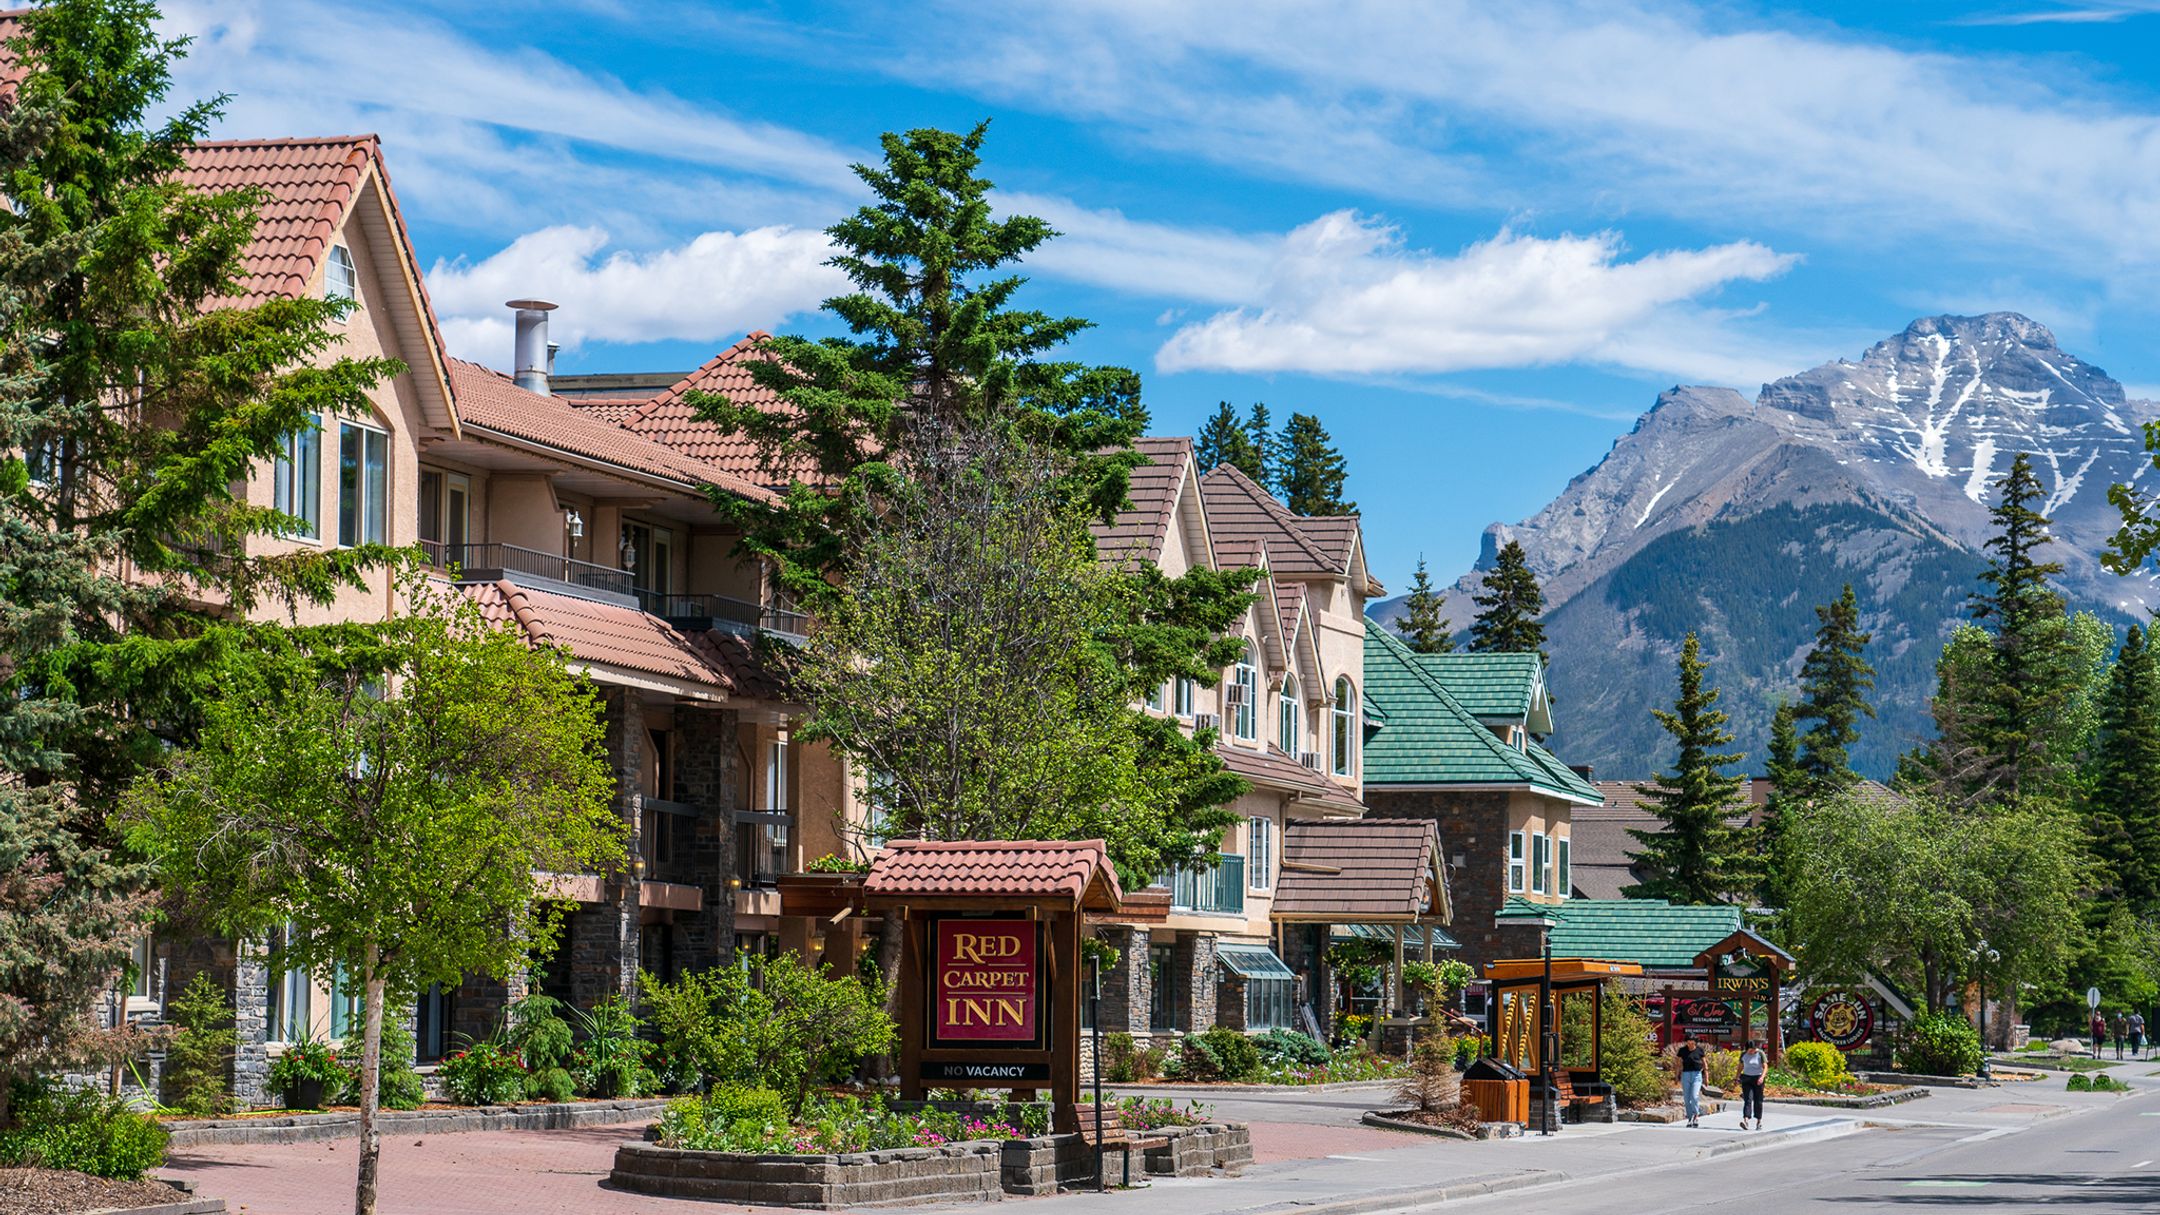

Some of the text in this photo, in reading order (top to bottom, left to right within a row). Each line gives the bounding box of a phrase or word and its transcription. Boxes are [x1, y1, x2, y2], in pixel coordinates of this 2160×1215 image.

[953, 934, 1021, 964] RED
[943, 971, 1029, 989] CARPET
[1717, 977, 1769, 992] IRWIN'S
[945, 998, 1027, 1026] INN
[1814, 993, 1867, 1020] SAMEUN
[944, 1066, 1025, 1077] NO VACANCY
